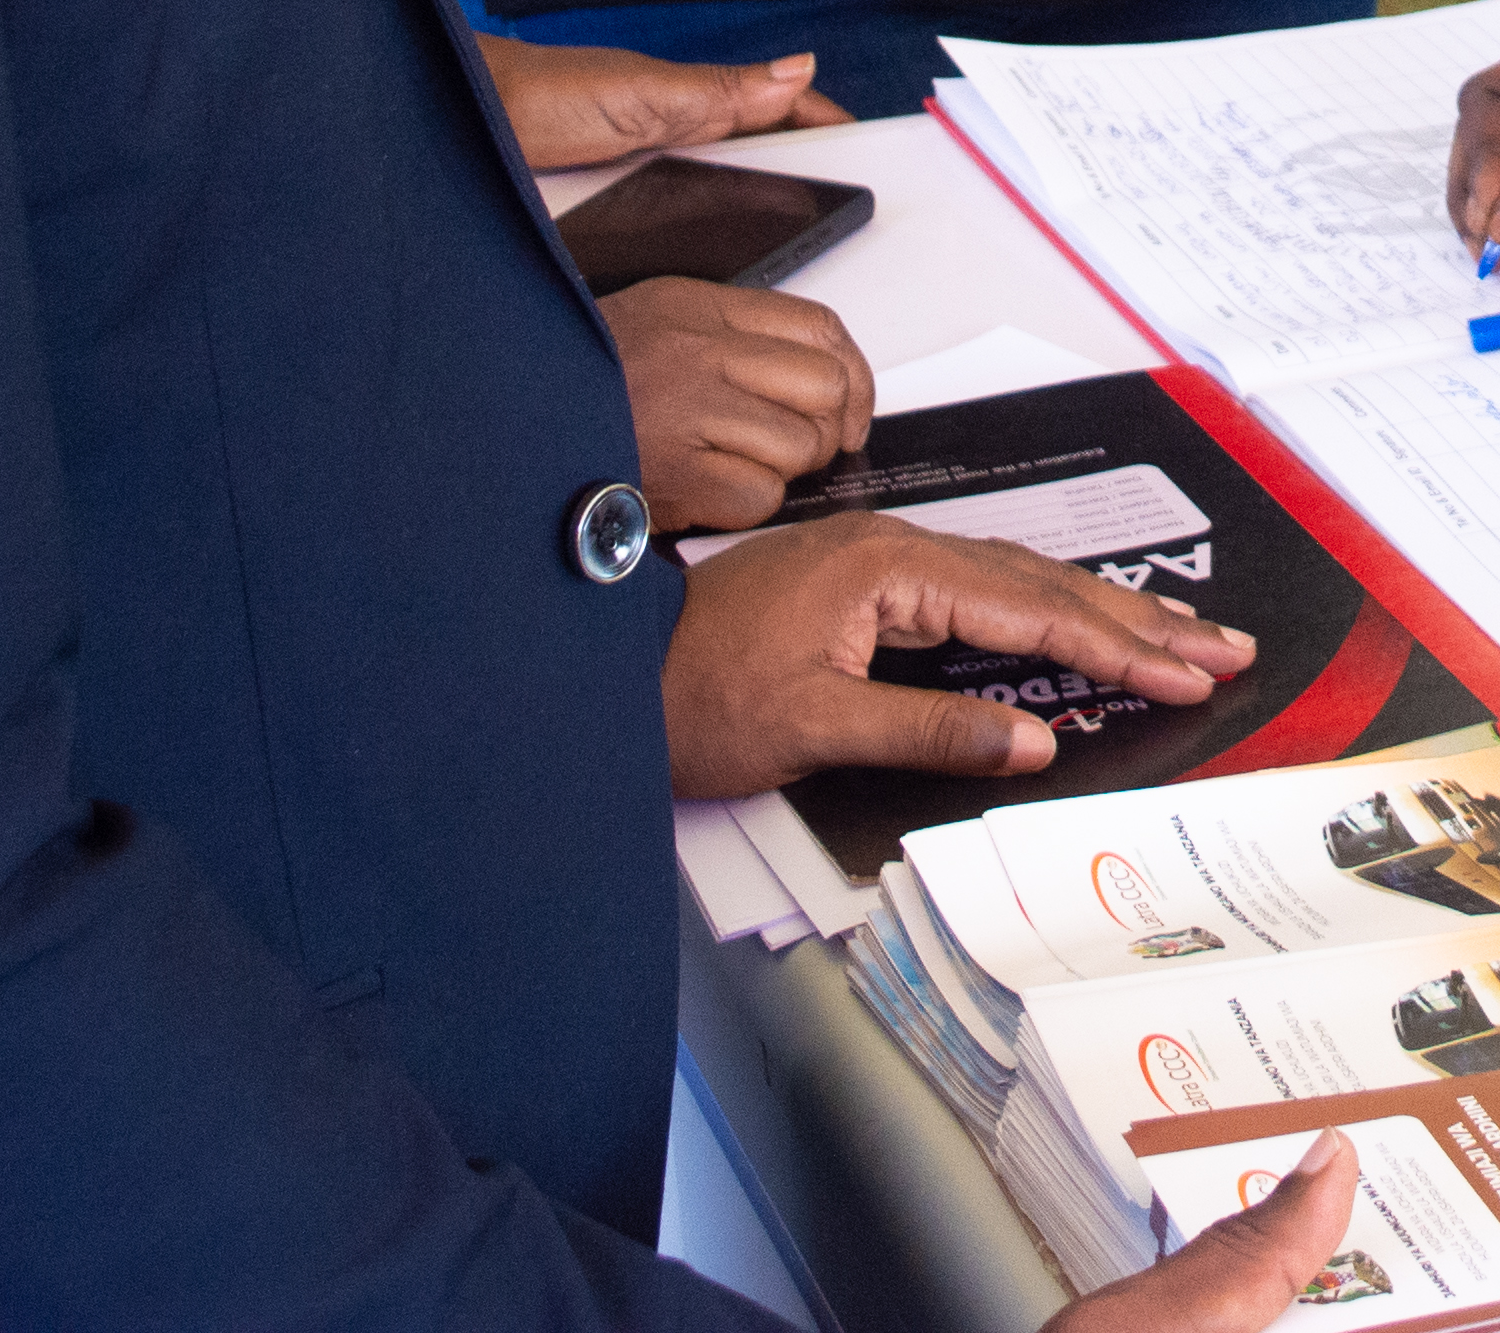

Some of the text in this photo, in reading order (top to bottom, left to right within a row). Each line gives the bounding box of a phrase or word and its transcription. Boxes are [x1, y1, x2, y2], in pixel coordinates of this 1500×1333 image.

[1166, 813, 1205, 867] TANZANIA
[1104, 867, 1166, 930] Latra CCC
[1196, 868, 1217, 884] WA
[1224, 996, 1274, 1065] WA TANZANIA
[1153, 1048, 1197, 1081] CCC
[1442, 1121, 1480, 1148] WA
[1357, 1181, 1458, 1299] JAMHURI YA MUUNGANO WA
